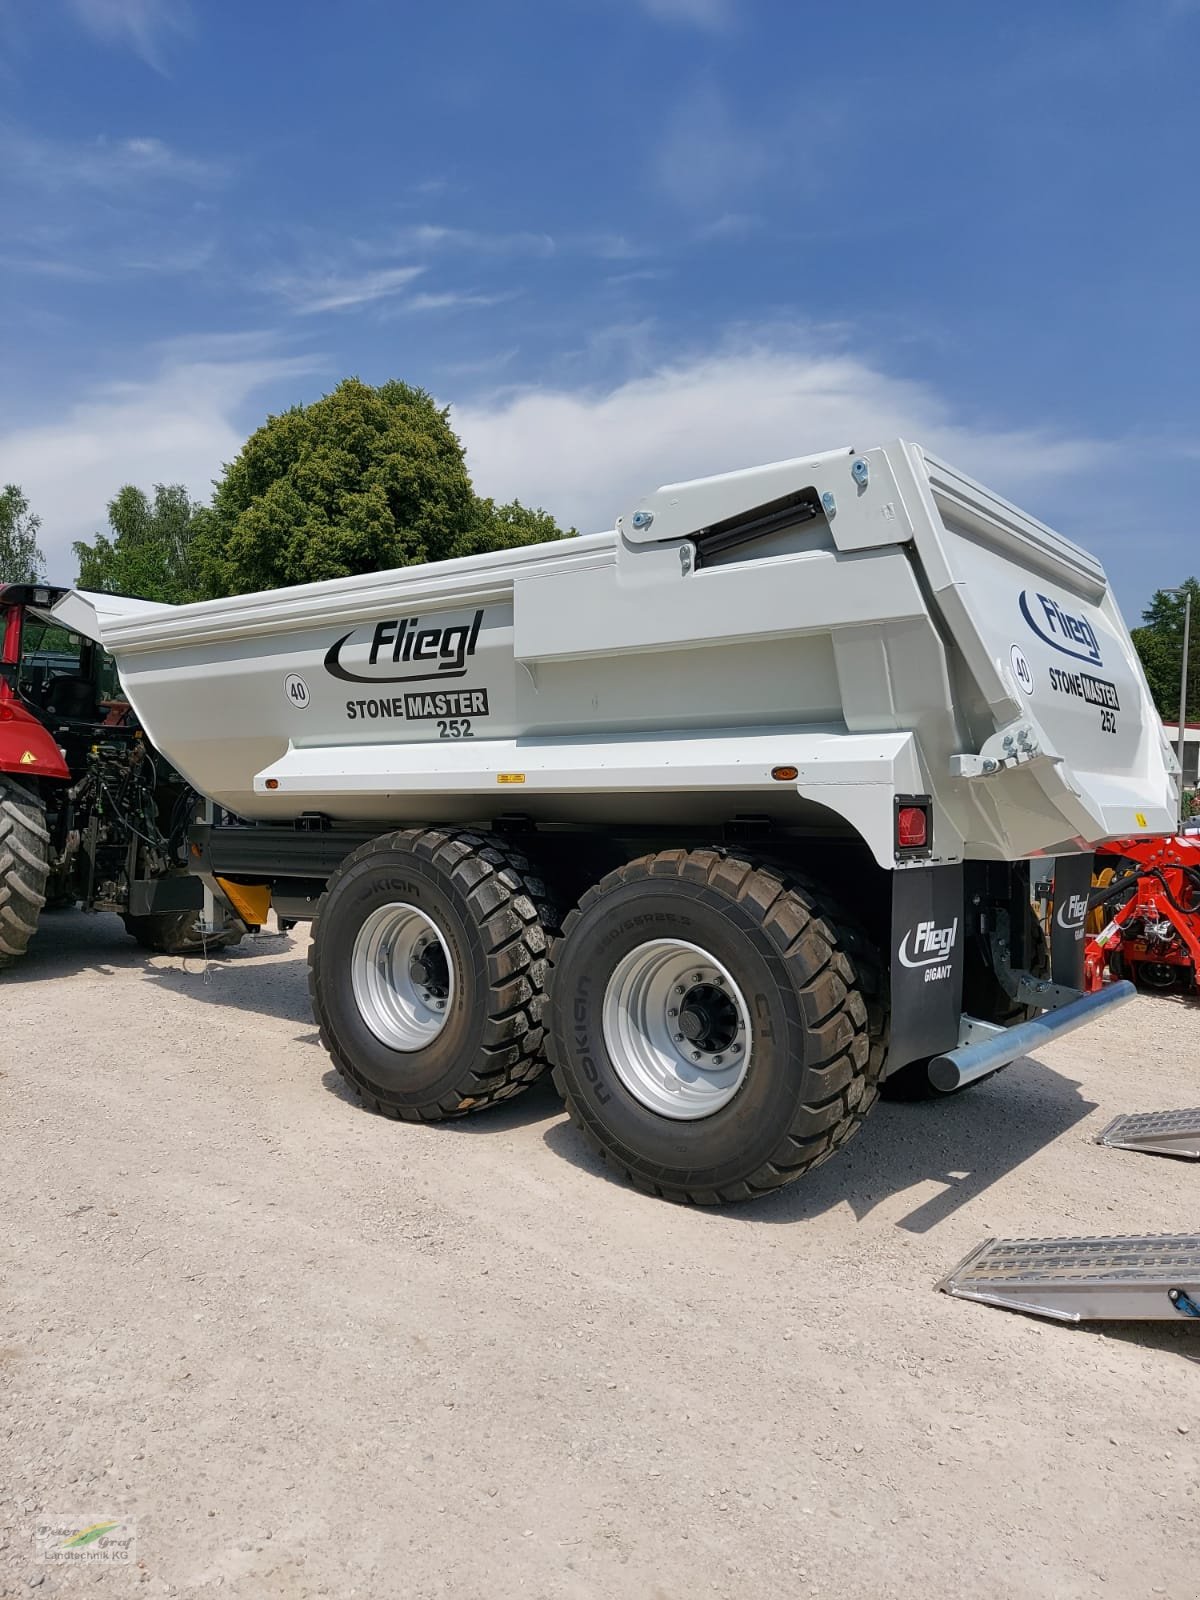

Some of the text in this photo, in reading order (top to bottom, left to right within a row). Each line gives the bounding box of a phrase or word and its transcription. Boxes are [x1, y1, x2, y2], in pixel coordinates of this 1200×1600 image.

[1035, 592, 1101, 660] Fliegl
[369, 609, 485, 670] Fliegl
[1016, 658, 1030, 683] 40
[290, 682, 306, 701] 40
[346, 690, 488, 719] STONE MASTER
[437, 719, 474, 738] 252
[1101, 710, 1116, 733] 252
[914, 917, 958, 956] Fliegl
[924, 964, 952, 983] GIGANT
